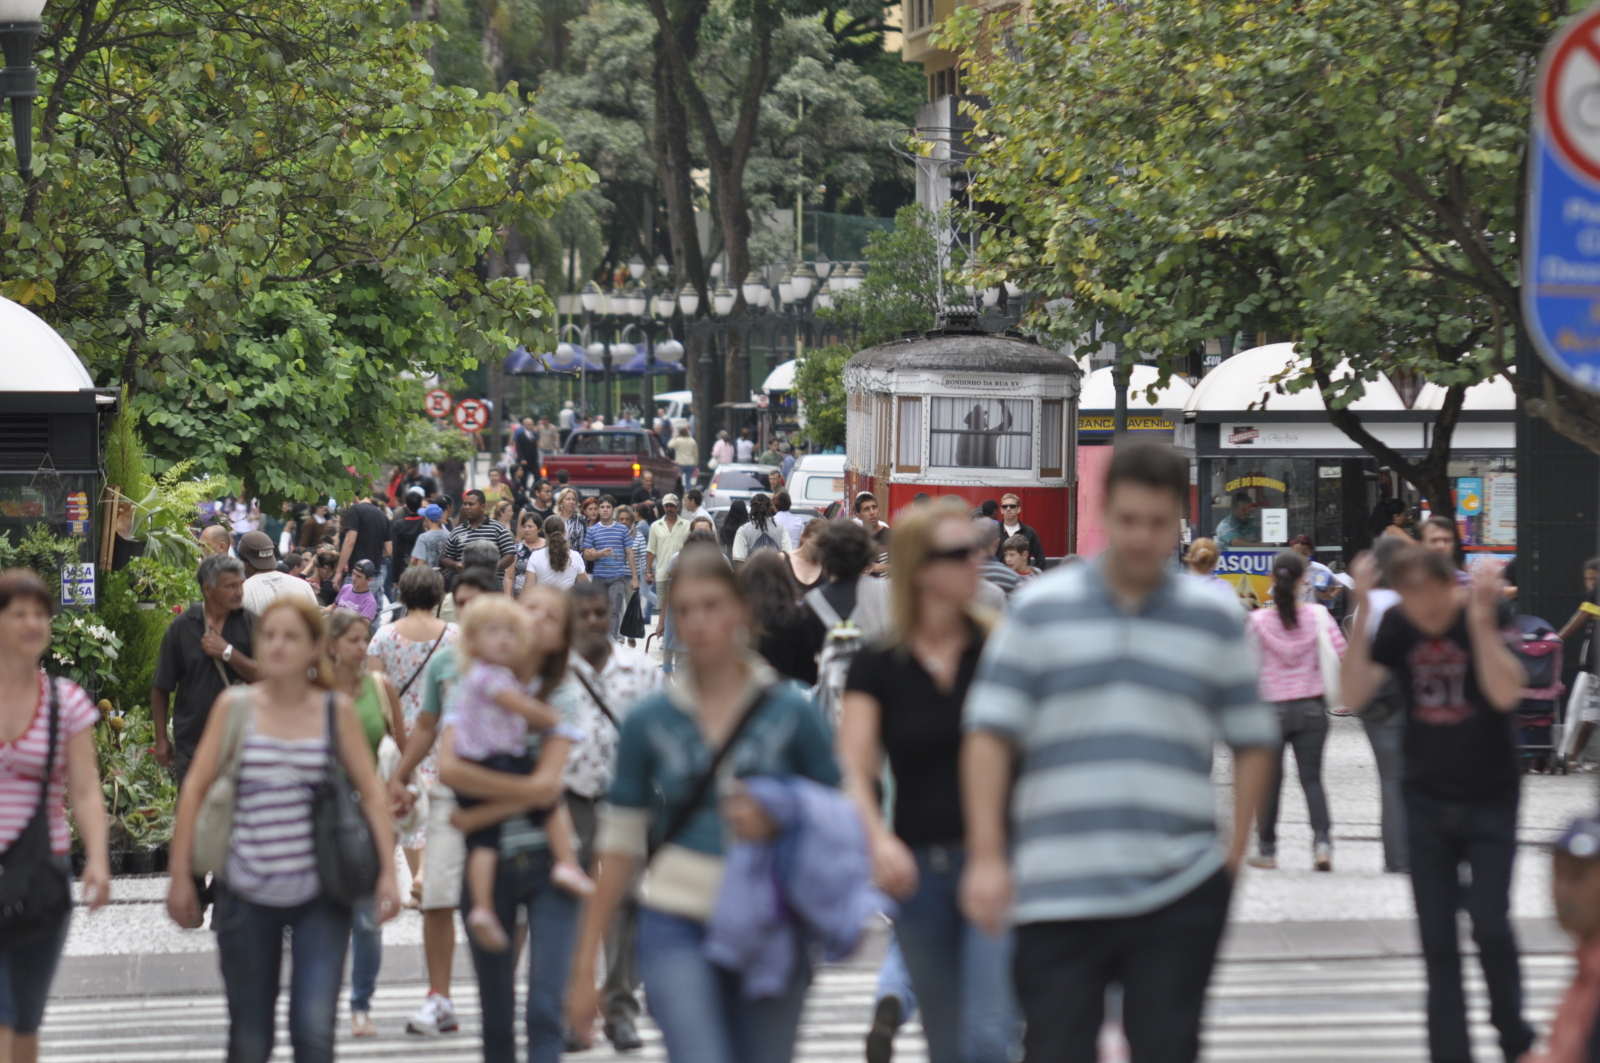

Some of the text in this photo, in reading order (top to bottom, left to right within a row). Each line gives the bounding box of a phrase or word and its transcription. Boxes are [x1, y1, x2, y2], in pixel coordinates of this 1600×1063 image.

[1078, 419, 1175, 428] BANC AVENID
[1241, 477, 1252, 487] DO
[1252, 476, 1286, 492] BONDINHO
[1215, 555, 1277, 575] ASQUI
